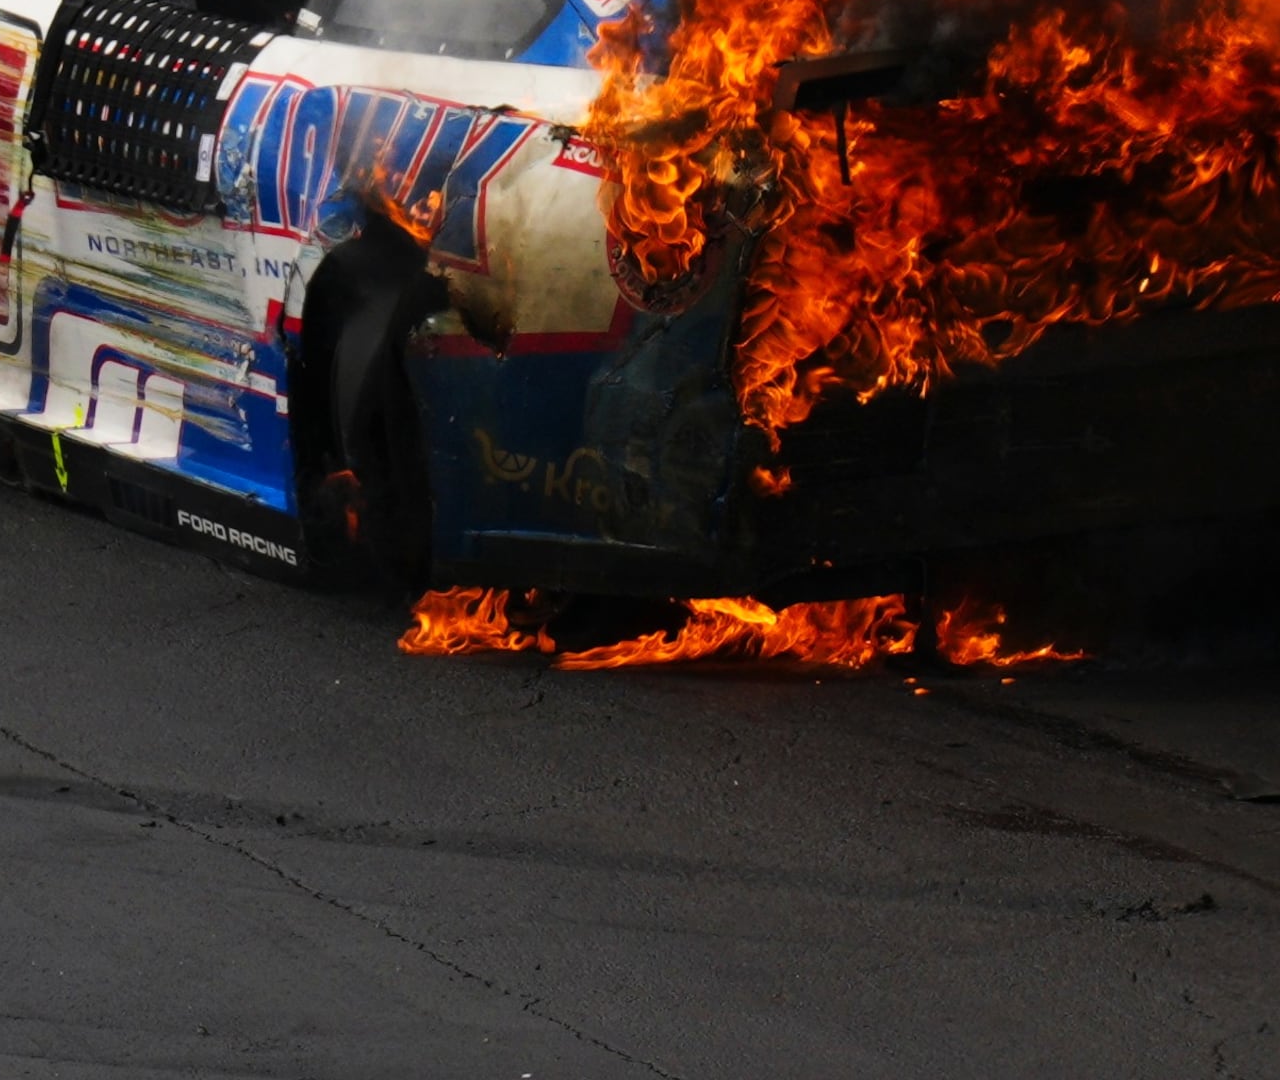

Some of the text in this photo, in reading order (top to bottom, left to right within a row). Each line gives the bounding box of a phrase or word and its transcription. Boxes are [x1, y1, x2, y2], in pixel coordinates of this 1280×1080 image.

[86, 233, 247, 278] NORTHEAST,
[177, 509, 298, 567] FORD RACING
